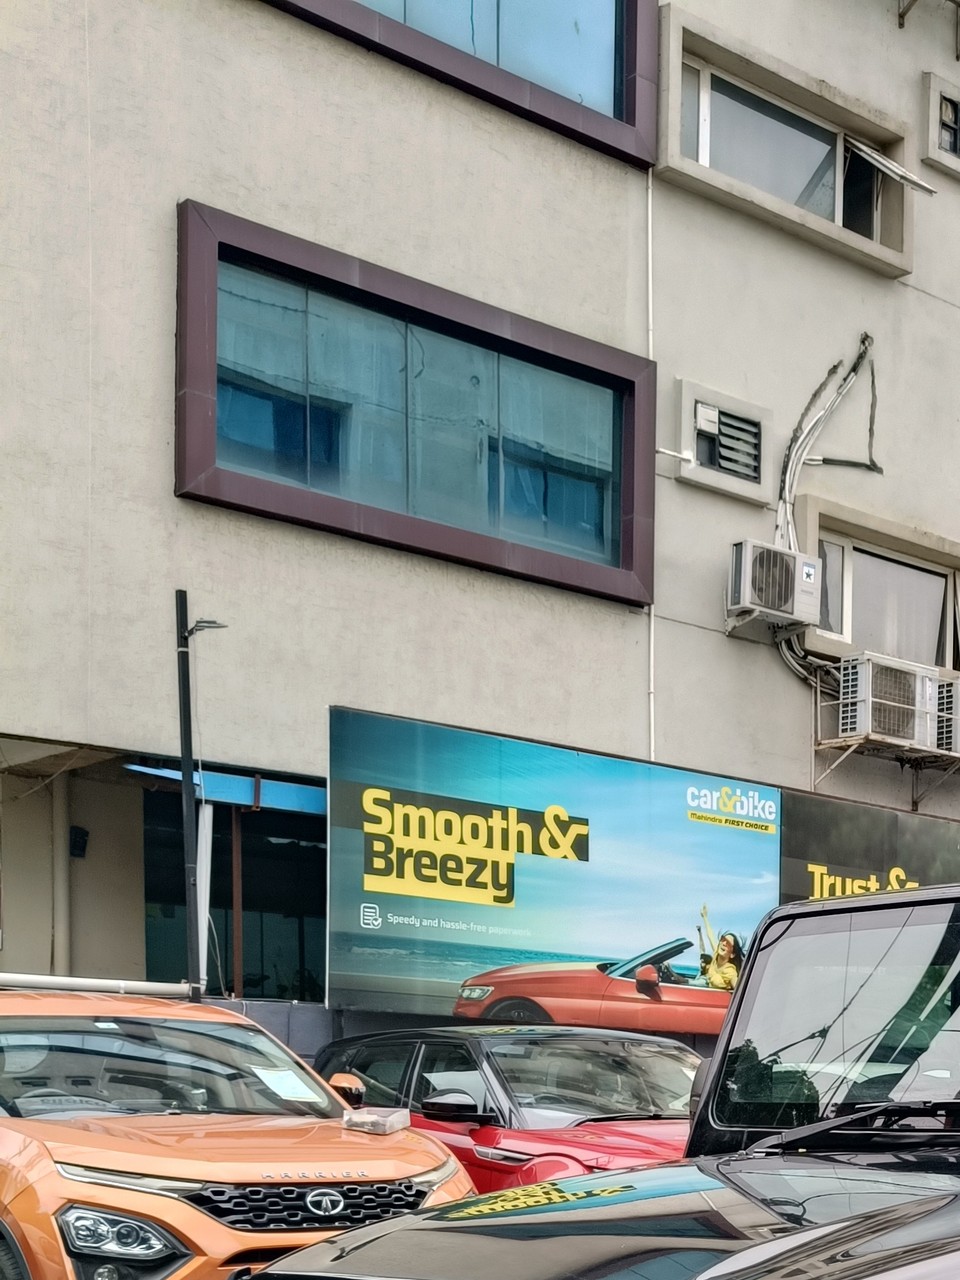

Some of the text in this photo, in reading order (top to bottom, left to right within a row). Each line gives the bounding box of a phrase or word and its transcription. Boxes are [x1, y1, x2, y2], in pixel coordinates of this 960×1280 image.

[686, 786, 777, 821] car&bike
[362, 788, 590, 861] Smooth &
[690, 812, 770, 832] Mahindra FIRST CHOICE
[364, 831, 514, 904] Breezy
[806, 863, 881, 900] Trust
[387, 912, 421, 928] Speedy
[422, 915, 439, 928] and
[440, 917, 487, 932] hassle-free
[261, 1171, 369, 1180] HARRIER
